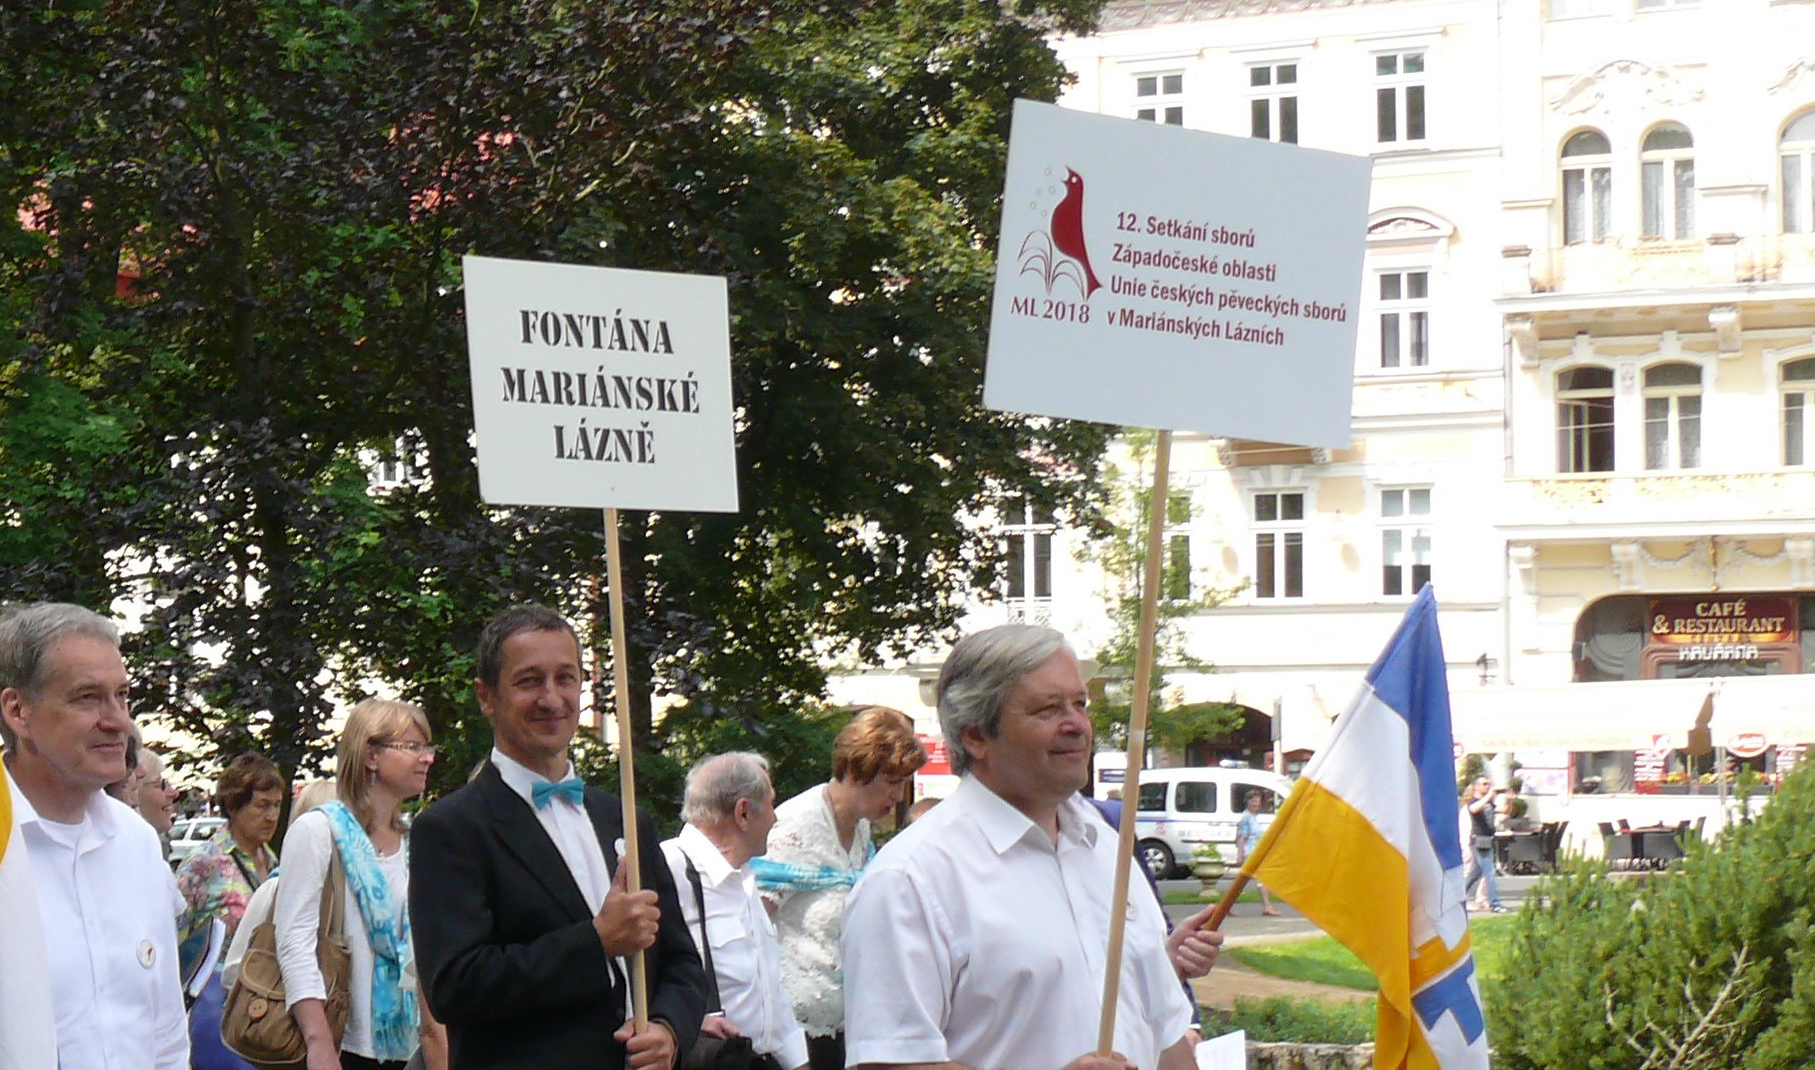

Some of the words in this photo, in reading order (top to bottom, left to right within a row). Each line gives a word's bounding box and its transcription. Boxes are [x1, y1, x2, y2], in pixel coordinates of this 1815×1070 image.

[1117, 212, 1142, 233] 12.
[1147, 216, 1207, 243] Setkání
[1212, 225, 1256, 249] sborů
[1112, 243, 1218, 276] Západočeské
[1223, 261, 1277, 283] oblasti
[1011, 296, 1039, 317] ML
[1043, 302, 1091, 324] 2018
[1111, 275, 1147, 298] Unie
[1151, 280, 1215, 308] českých
[1219, 289, 1299, 320] pěveckých
[1303, 302, 1347, 323] sborů
[519, 308, 674, 354] FONTÁNA
[1108, 312, 1117, 325] v
[1119, 310, 1221, 340] Mariánských
[1225, 323, 1285, 346] Lázních
[500, 365, 700, 414] MARIÁNSKÉ
[553, 417, 655, 463] LÁZNĚ
[1652, 615, 1670, 634] &
[1674, 617, 1785, 634] RESTAURANT
[1695, 599, 1746, 617] CAFÉ
